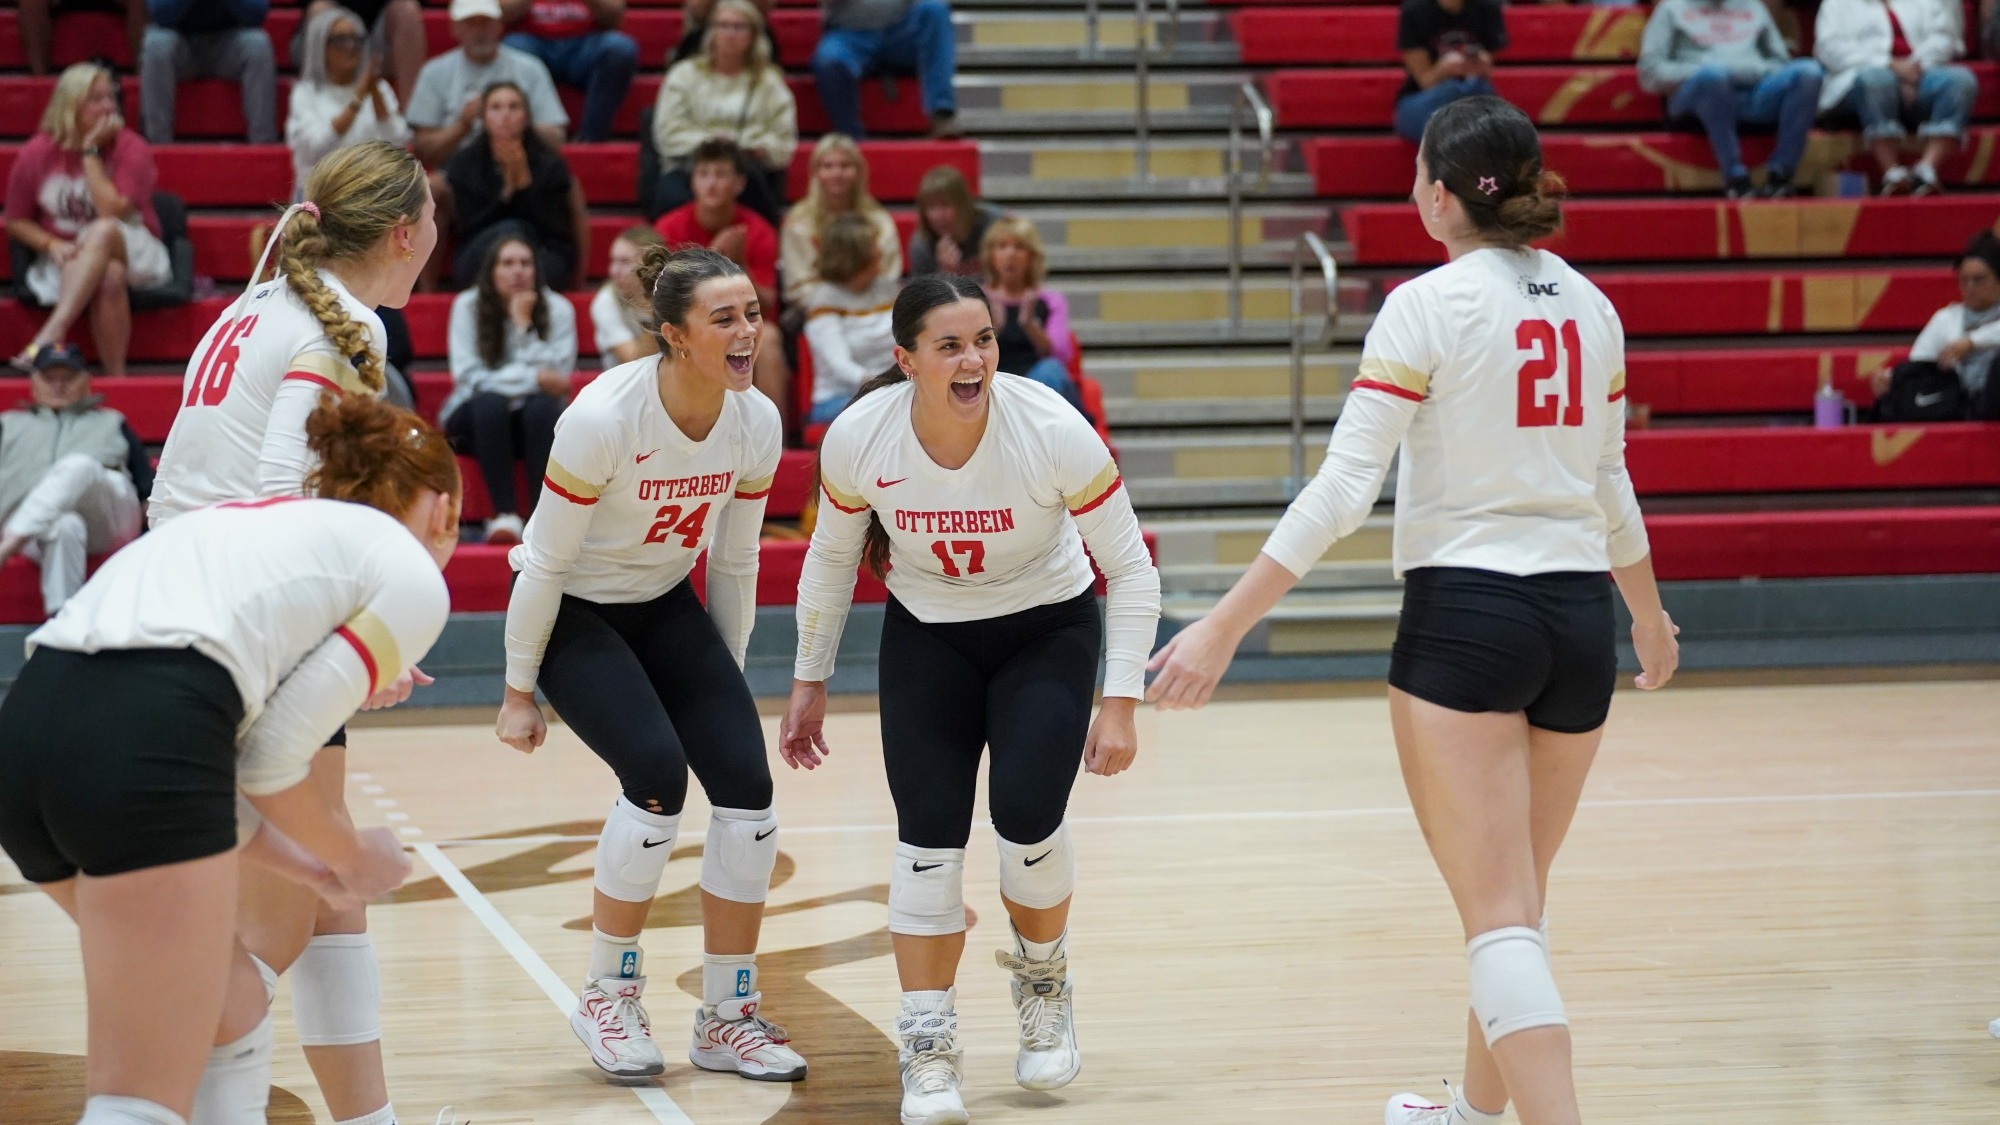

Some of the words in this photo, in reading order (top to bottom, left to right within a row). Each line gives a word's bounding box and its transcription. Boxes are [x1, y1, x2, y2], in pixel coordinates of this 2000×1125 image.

[185, 314, 259, 408] 16
[1515, 319, 1583, 427] 21
[641, 502, 712, 548] 24
[895, 508, 1015, 533] OTTERBEIN
[930, 540, 985, 577] 17
